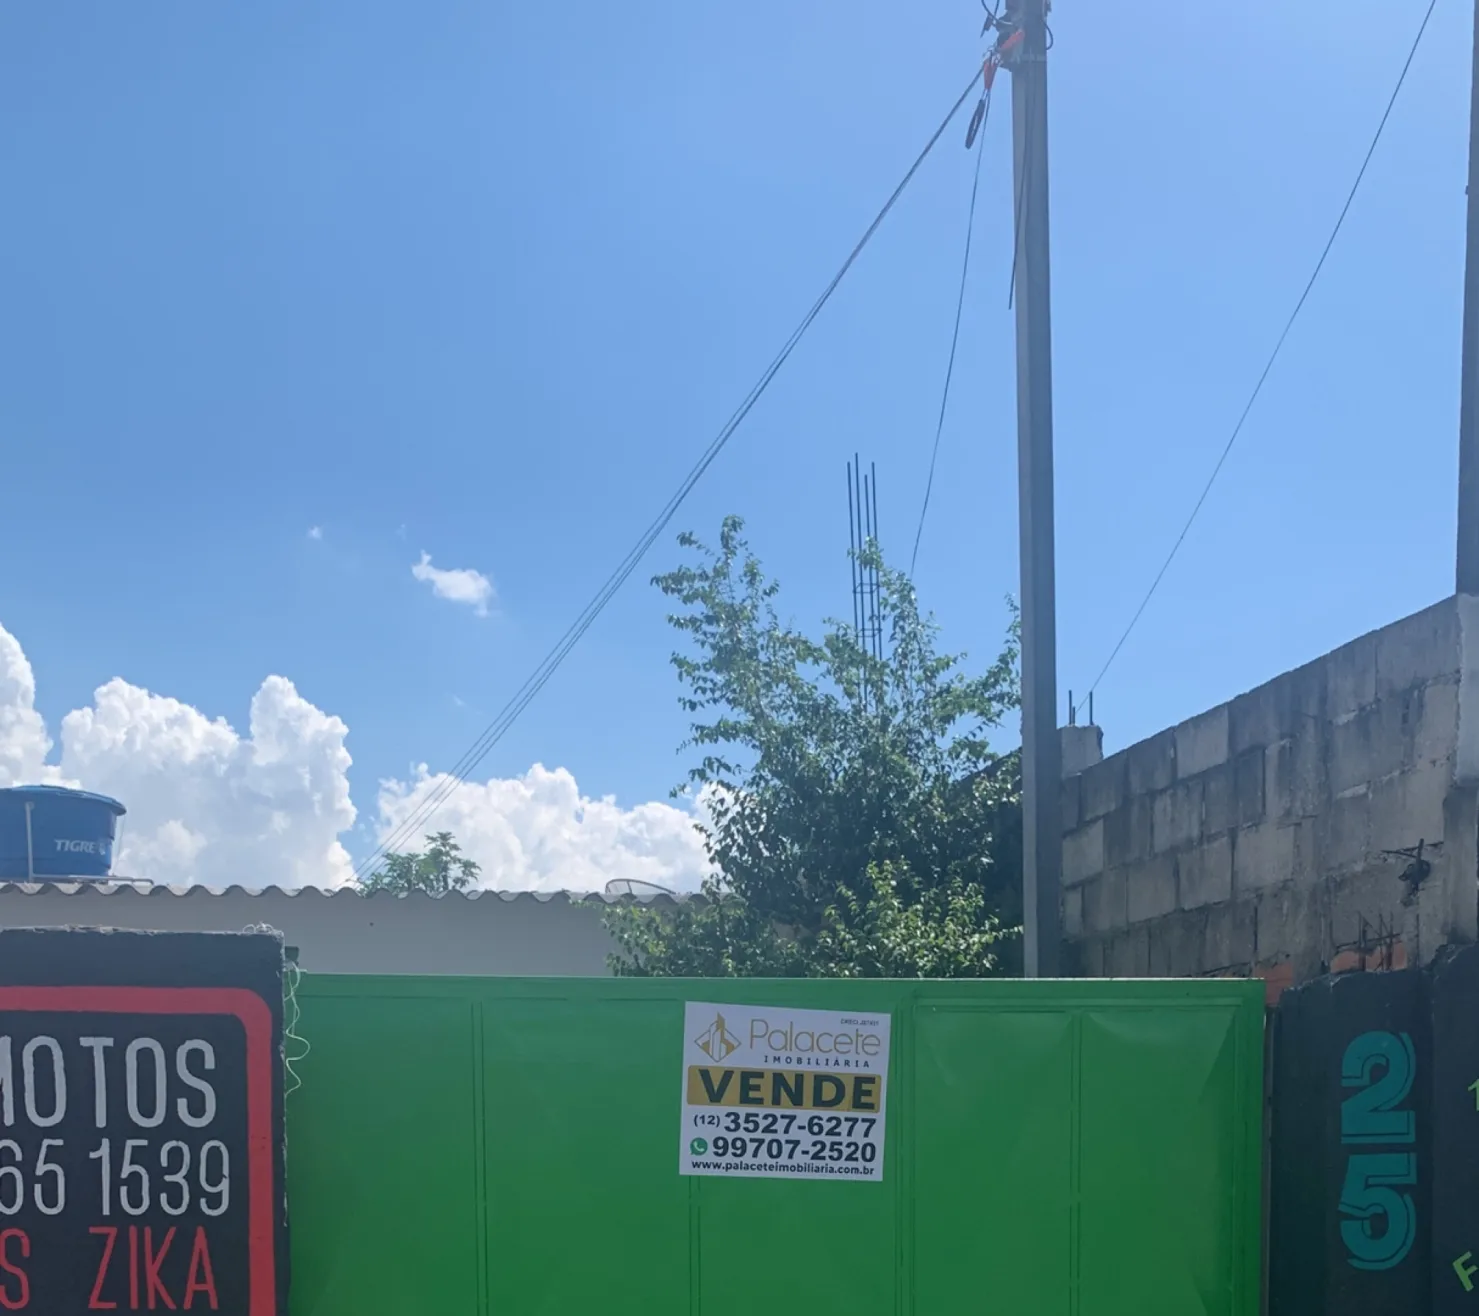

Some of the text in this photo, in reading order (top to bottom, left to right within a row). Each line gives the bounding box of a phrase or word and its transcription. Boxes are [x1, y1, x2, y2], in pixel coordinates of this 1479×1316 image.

[54, 838, 96, 854] TIGRE
[750, 1018, 881, 1056] Palacete
[764, 1055, 870, 1068] IMOBILIÁRIA
[698, 1069, 876, 1110] VENDE
[693, 1111, 877, 1138] (12) 3527-6277
[712, 1136, 876, 1162] 99707-2520
[1338, 1030, 1417, 1271] 25
[88, 1138, 230, 1217] 1539
[691, 1160, 875, 1175] www.palaceteimobiliaria.com.br
[87, 1225, 219, 1310] ZIKA
